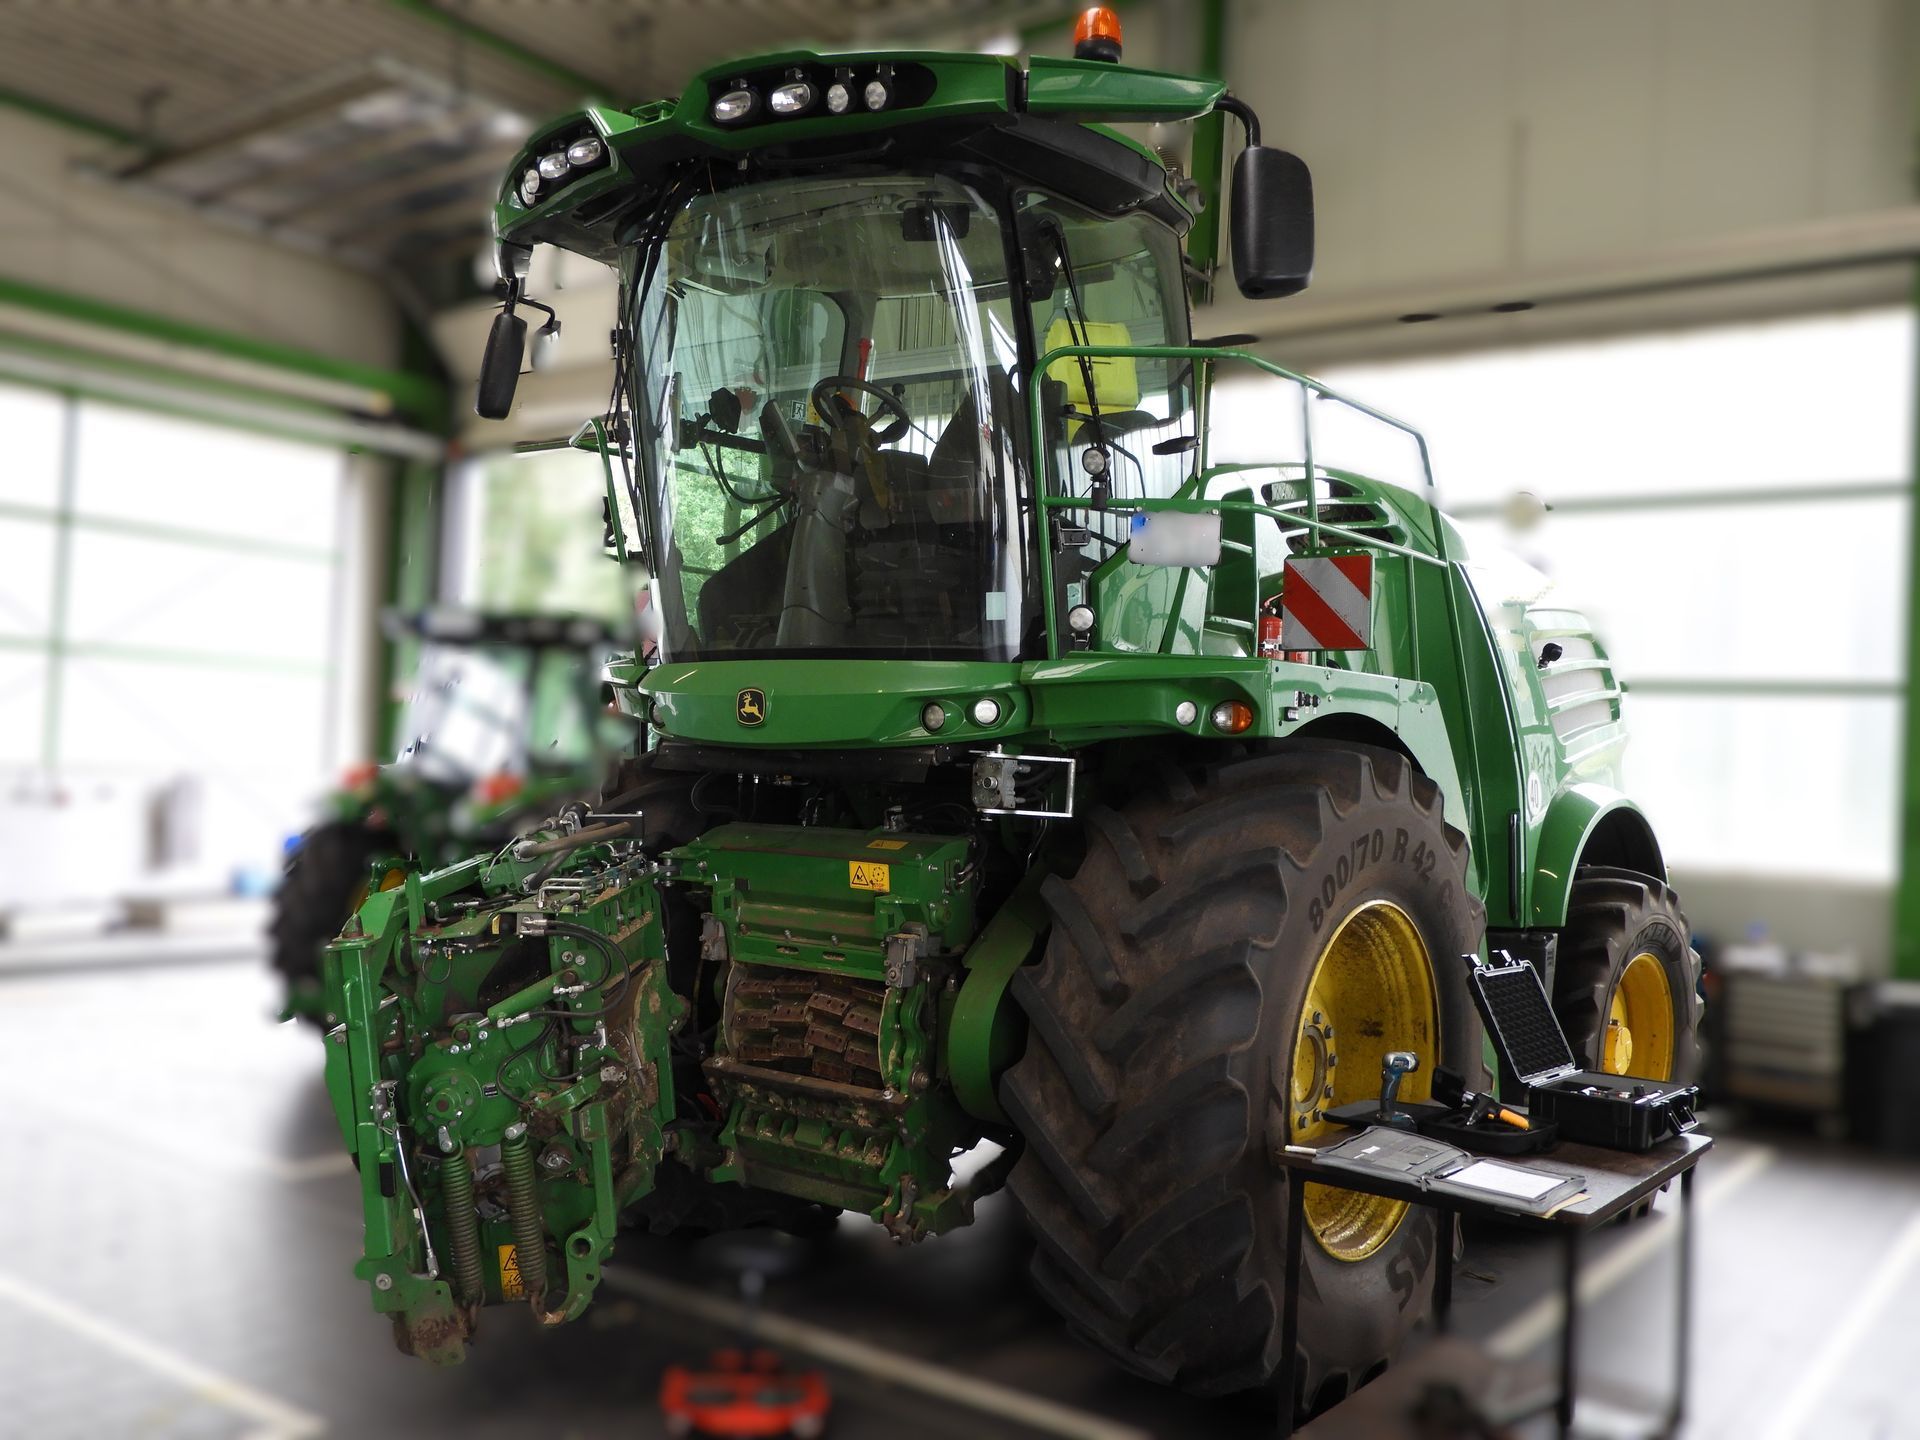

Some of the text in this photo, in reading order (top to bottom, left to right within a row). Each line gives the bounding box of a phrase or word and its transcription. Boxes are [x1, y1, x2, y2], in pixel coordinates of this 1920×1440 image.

[1308, 827, 1436, 933] 800/70 R 42
